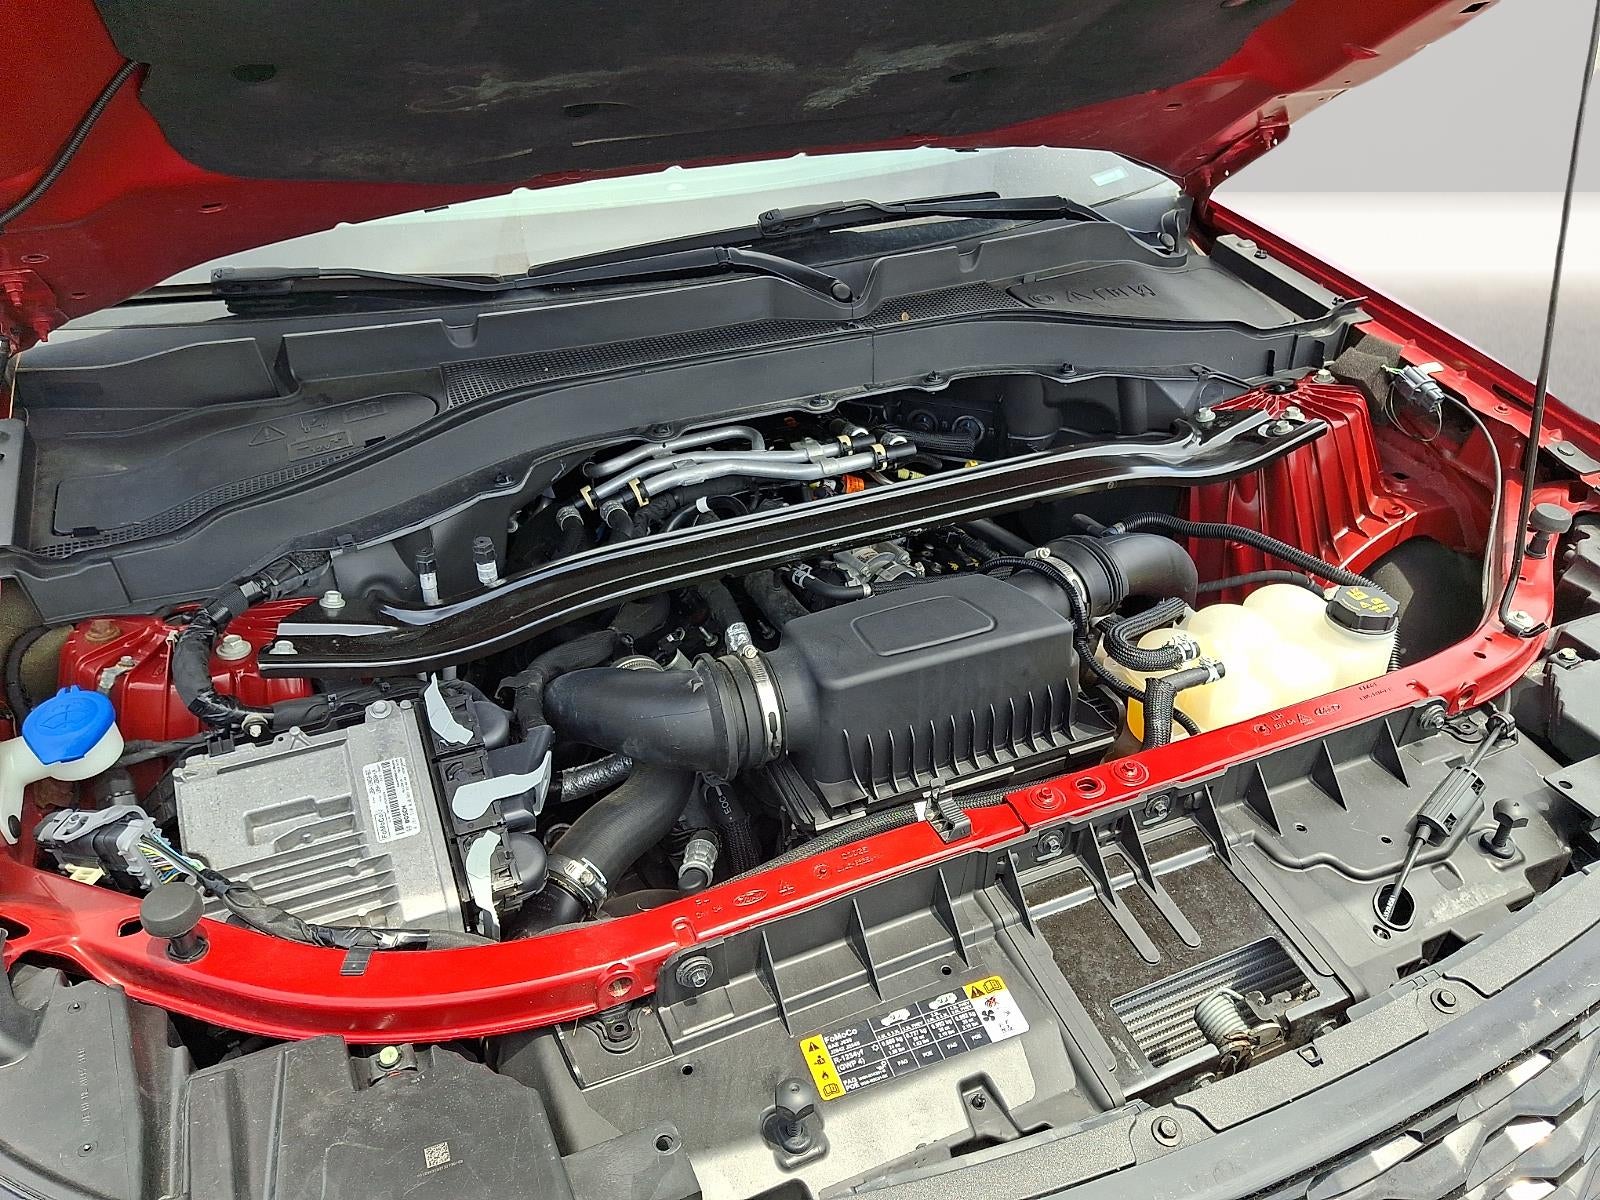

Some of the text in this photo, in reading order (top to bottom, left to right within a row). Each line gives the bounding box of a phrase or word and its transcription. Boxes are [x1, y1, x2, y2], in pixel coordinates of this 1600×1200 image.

[402, 805, 410, 823] BOSCH
[378, 814, 387, 838] FoMoCo
[824, 1029, 857, 1044] FoMoCo
[833, 1049, 863, 1064] R-1234yf
[843, 1077, 857, 1085] PAG
